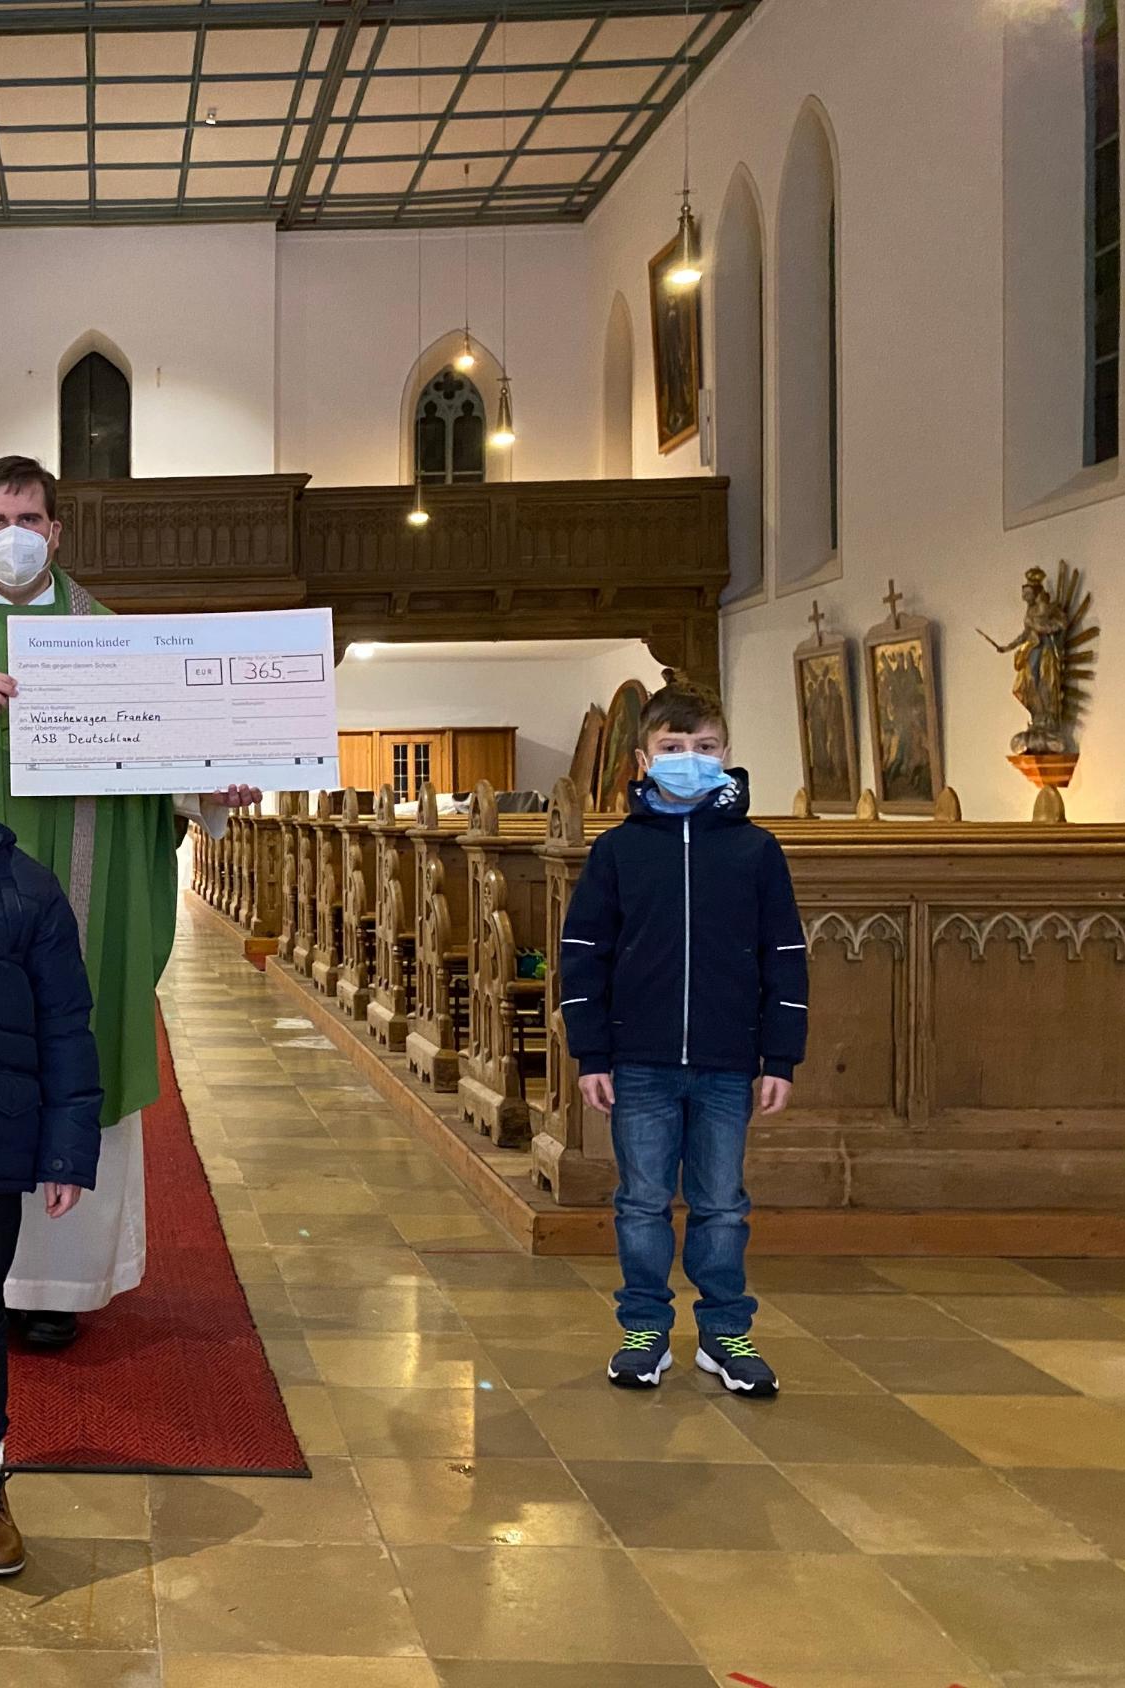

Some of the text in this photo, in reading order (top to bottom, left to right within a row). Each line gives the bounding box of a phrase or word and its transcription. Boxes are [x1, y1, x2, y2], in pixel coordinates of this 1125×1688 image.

[154, 635, 194, 646] Tschirn
[29, 710, 161, 726] Wünschewagen Franken
[31, 732, 141, 744] ASB Deutschland
